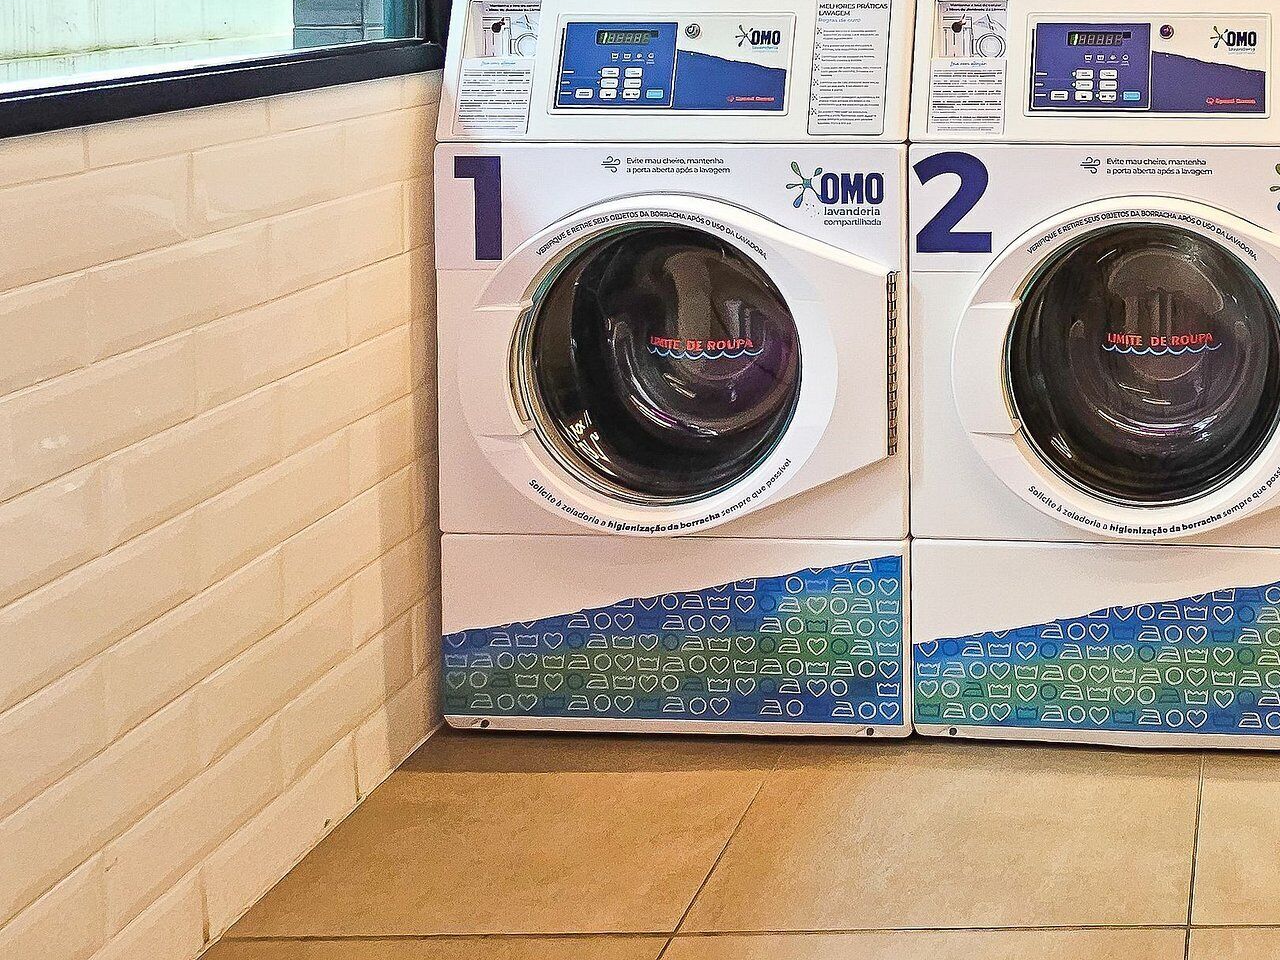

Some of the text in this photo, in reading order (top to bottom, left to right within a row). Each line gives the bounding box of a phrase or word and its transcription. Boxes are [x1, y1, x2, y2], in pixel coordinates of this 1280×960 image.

[751, 30, 781, 45] OMO
[1227, 31, 1257, 47] OMO
[1143, 158, 1167, 166] cheiro,
[675, 166, 693, 174] após
[1157, 167, 1175, 175] após
[1181, 168, 1213, 176] lavagem
[821, 173, 884, 205] OMO
[454, 156, 502, 261] 1
[912, 151, 992, 254] 2
[824, 206, 880, 216] lavanderia
[824, 218, 881, 227] compartilhada
[1108, 332, 1213, 347] LIMITE DE ROUPA
